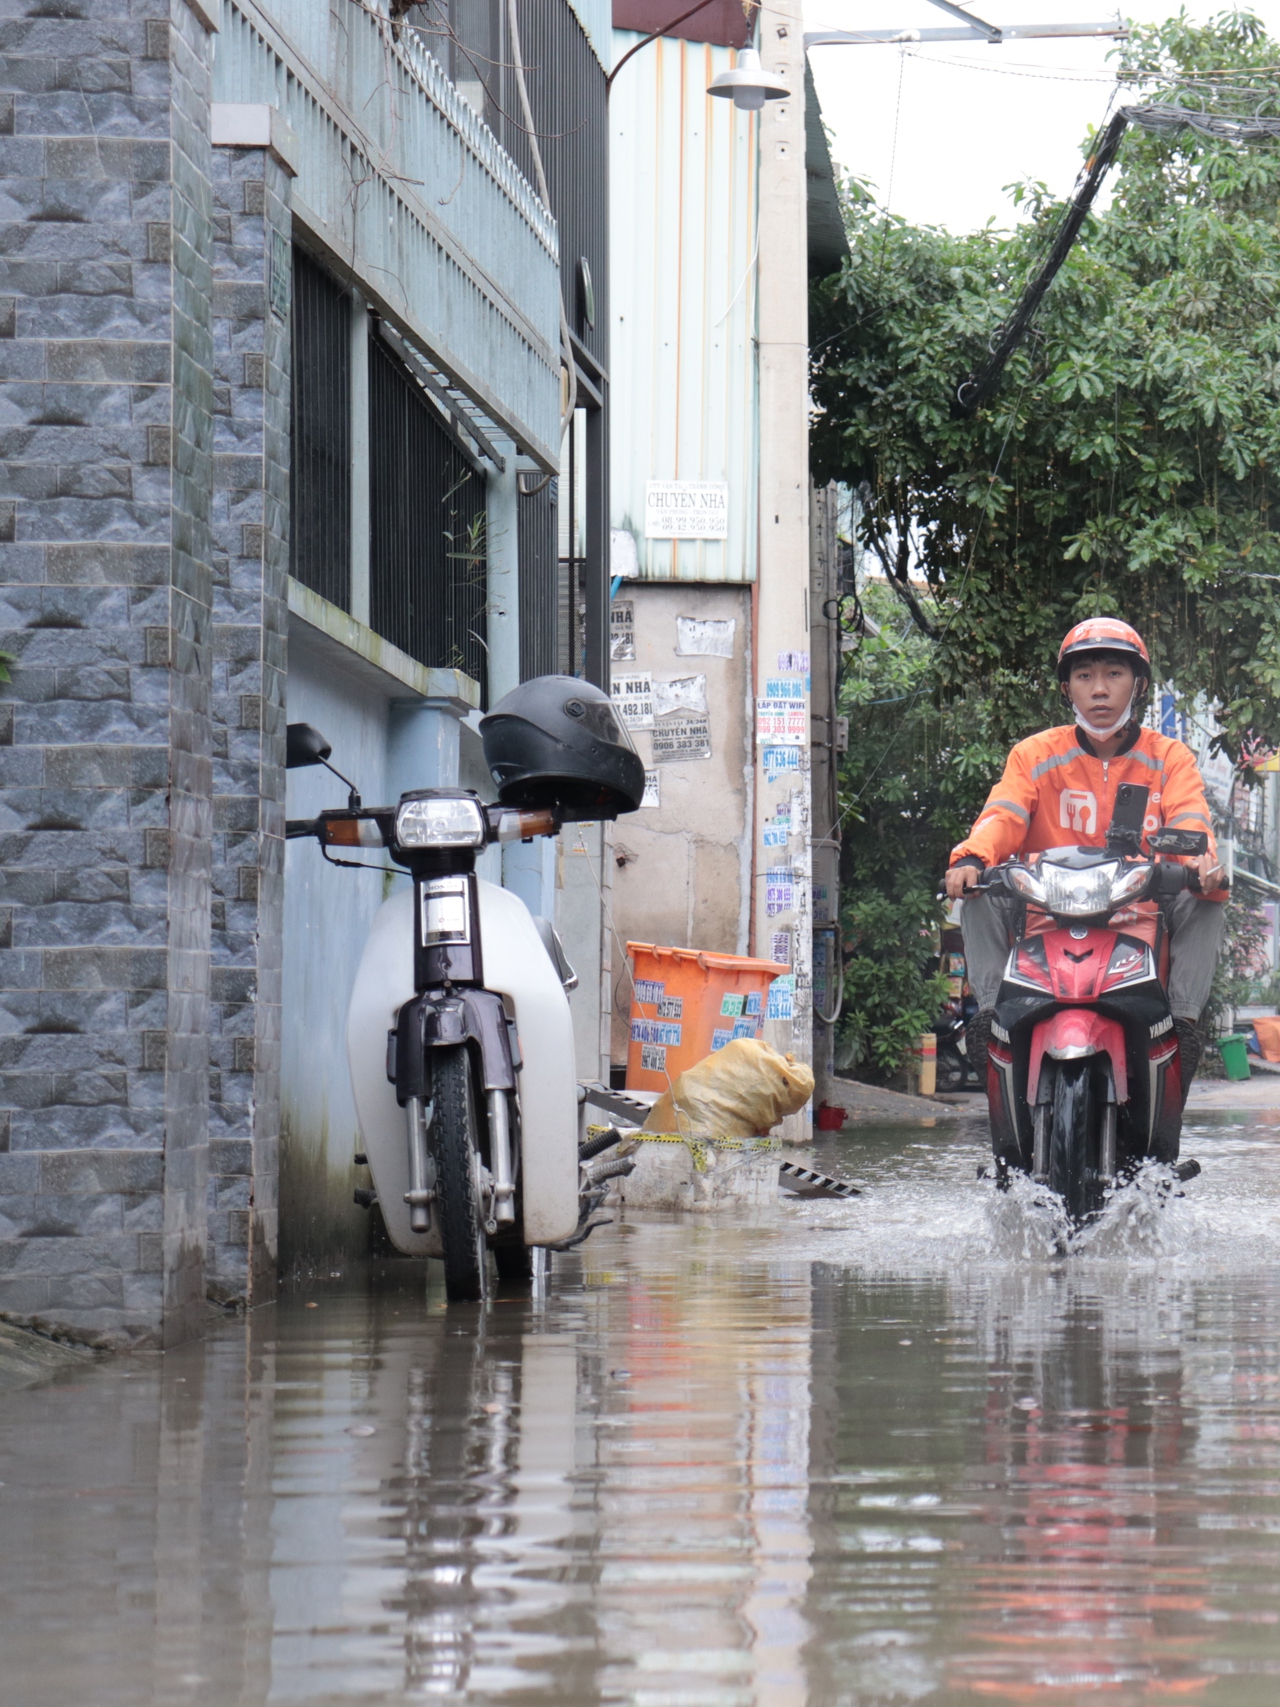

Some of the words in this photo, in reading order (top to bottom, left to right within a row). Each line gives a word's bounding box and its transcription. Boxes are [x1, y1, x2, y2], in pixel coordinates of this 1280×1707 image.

[625, 678, 652, 693] NHÀ
[773, 717, 785, 725] 151
[787, 717, 805, 725] 7777
[1149, 1014, 1174, 1039] YAMAHA
